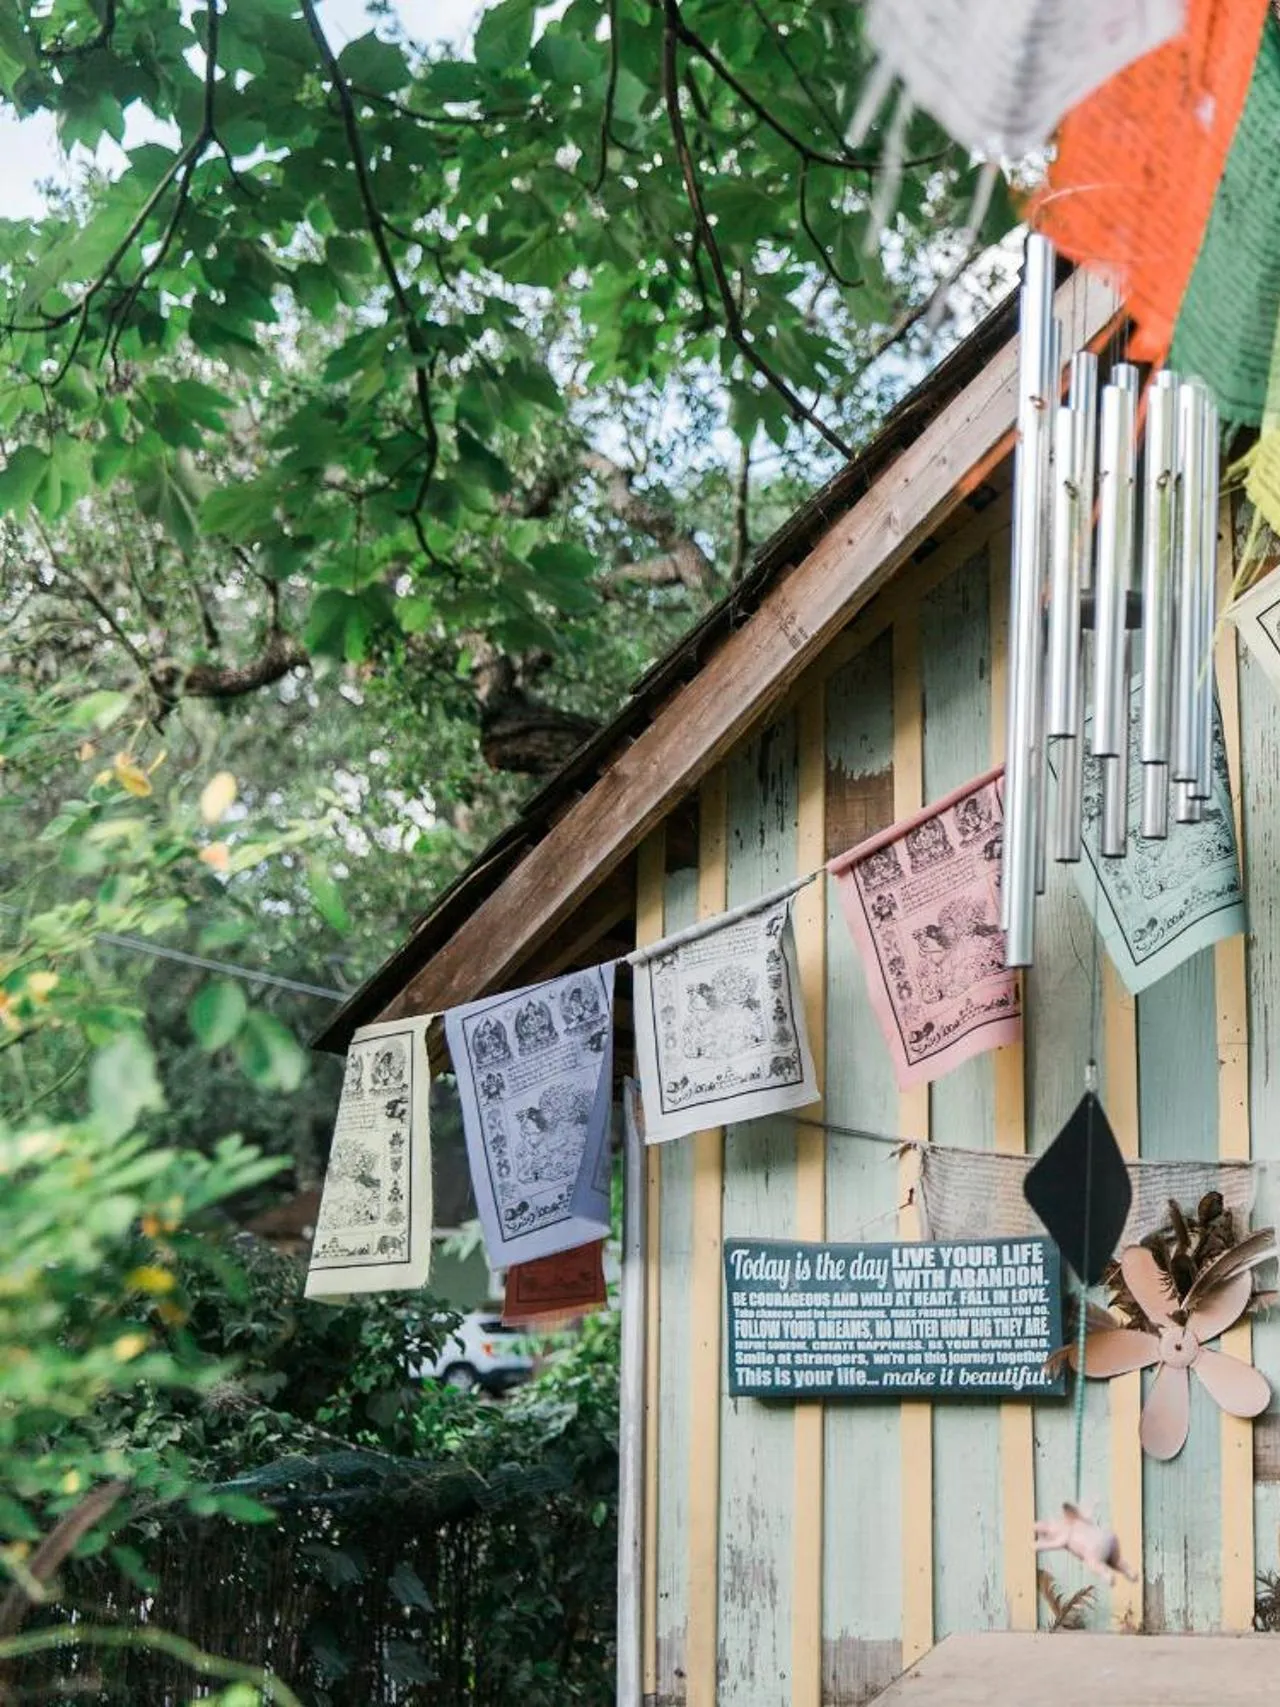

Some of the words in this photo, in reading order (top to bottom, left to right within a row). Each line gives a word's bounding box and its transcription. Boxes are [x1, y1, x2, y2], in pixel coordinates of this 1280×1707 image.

[892, 1248, 936, 1268] LIVE
[939, 1246, 998, 1268] YOUR
[1002, 1243, 1044, 1265] LIFE
[730, 1249, 791, 1290] Today
[795, 1252, 811, 1281] is
[816, 1252, 846, 1281] the
[850, 1252, 888, 1289] day
[893, 1269, 947, 1289] WITH
[950, 1265, 1050, 1289] ABANDON.
[732, 1292, 748, 1306] BE
[750, 1292, 830, 1307] COURAGEOUS
[832, 1291, 859, 1307] AND
[860, 1291, 893, 1306] WILD
[895, 1291, 911, 1306] AT
[914, 1290, 957, 1305] HEART.
[960, 1289, 990, 1305] FALL
[993, 1289, 1009, 1303] IN
[1012, 1287, 1050, 1303] LOVE.
[1012, 1306, 1032, 1316] YOU
[735, 1319, 781, 1339] FOLLOW
[782, 1319, 817, 1339] YOUR
[819, 1319, 874, 1340] DREAMS,
[876, 1319, 892, 1339] NO
[894, 1318, 939, 1339] MATTER
[941, 1318, 970, 1338] HOW
[971, 1318, 992, 1338] BIG
[994, 1317, 1023, 1337] THEY
[946, 1340, 979, 1349] YOUR
[981, 1339, 1012, 1349] OWN
[735, 1352, 775, 1365] Smile
[777, 1353, 792, 1365] at
[795, 1353, 870, 1366] strangers,
[907, 1353, 922, 1364] on
[924, 1351, 948, 1364] this
[949, 1351, 995, 1365] journey
[735, 1367, 772, 1386] This
[774, 1367, 792, 1386] is
[793, 1370, 834, 1388] your
[882, 1368, 936, 1386] make
[940, 1367, 954, 1385] it
